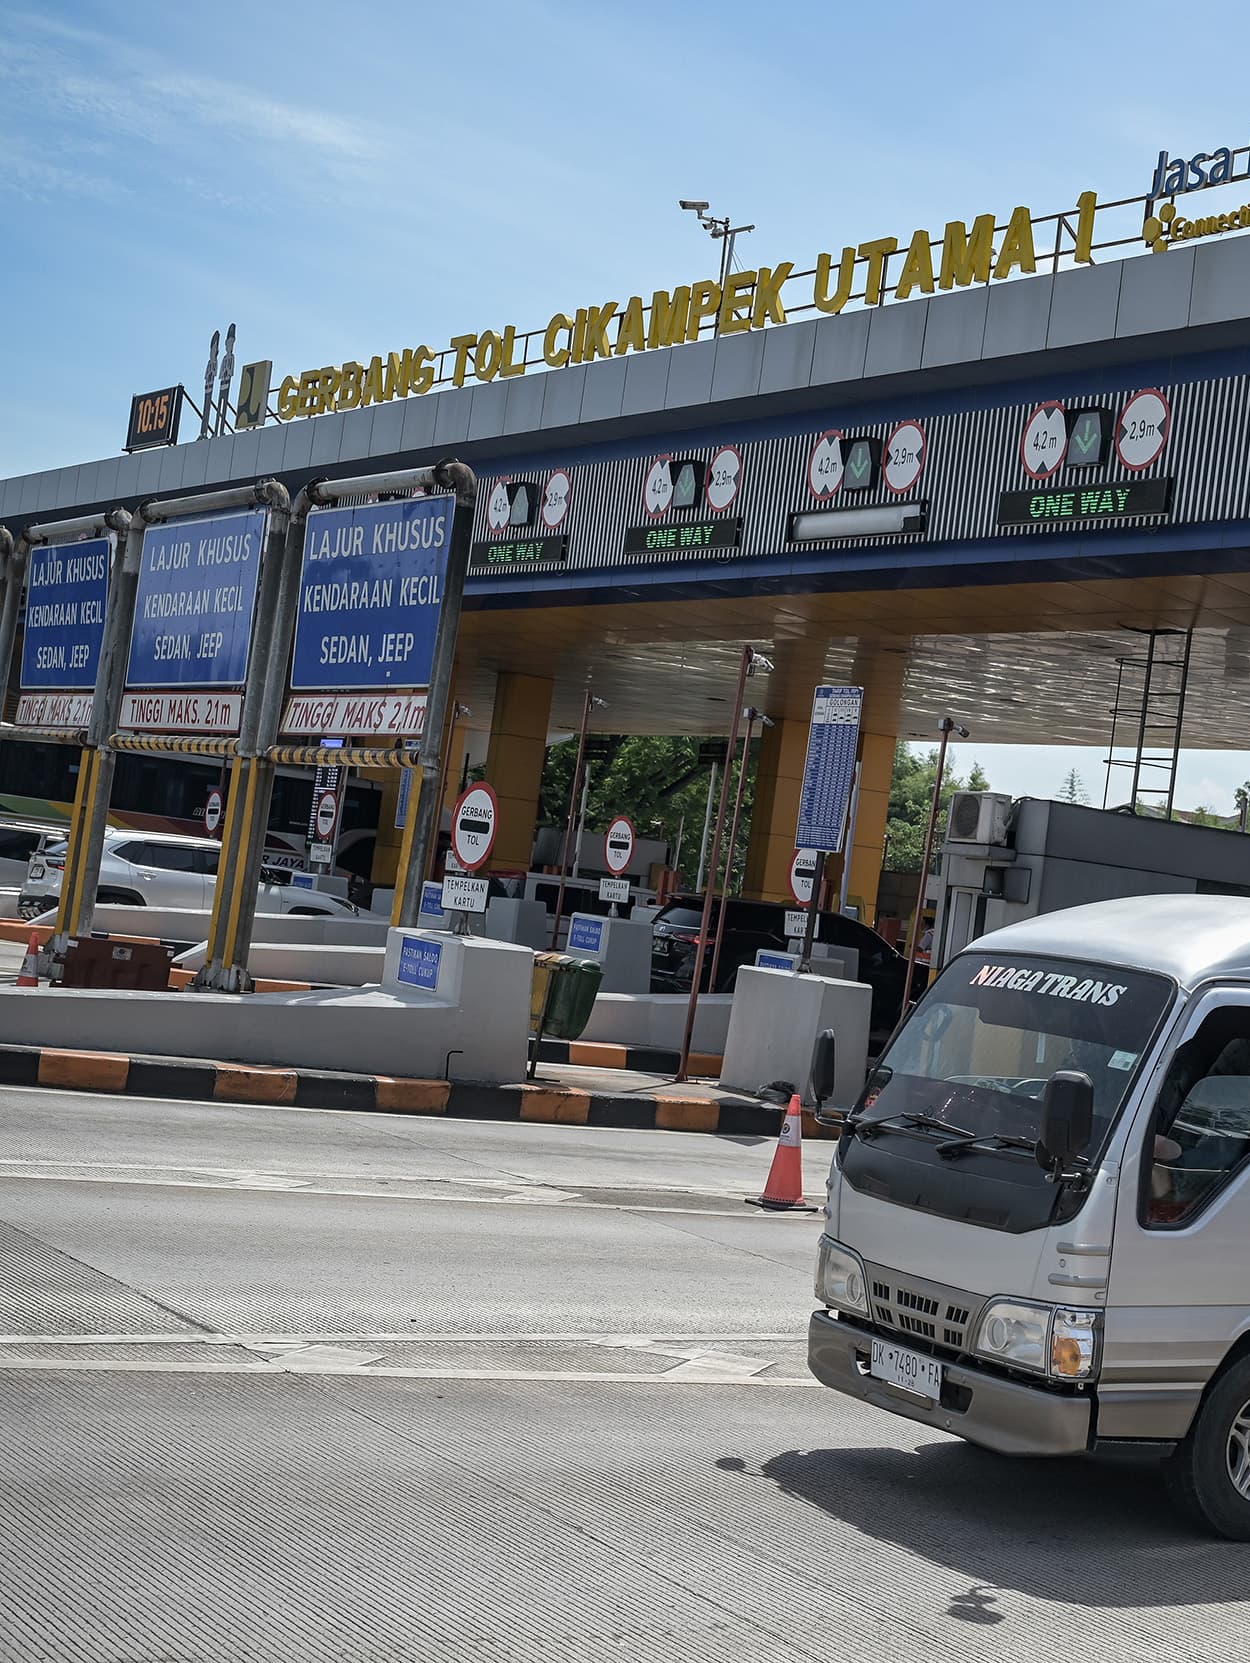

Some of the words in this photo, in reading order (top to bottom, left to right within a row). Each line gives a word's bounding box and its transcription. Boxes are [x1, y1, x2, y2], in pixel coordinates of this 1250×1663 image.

[1146, 145, 1234, 200] Jasa
[277, 345, 436, 421] GERBANG
[451, 325, 526, 388] TOL
[543, 262, 795, 368] CIKAMPEK
[813, 206, 1037, 314] UTAMA
[136, 394, 170, 436] 10:15
[1029, 495, 1075, 518] ONE
[1080, 488, 1130, 514] WAY
[309, 526, 364, 561] LAJUR
[372, 516, 446, 554] KHUSUS
[646, 529, 676, 548] ONE
[680, 525, 715, 545] WAY
[150, 542, 191, 572] LAJUR
[198, 533, 252, 566] KHUSUS
[488, 545, 513, 562] ONE
[516, 543, 543, 561] WAY
[32, 560, 63, 587] LAJUR
[66, 554, 105, 584] KHUSUS
[143, 589, 211, 619] KENDARAAN
[213, 585, 243, 616] KECIL
[303, 578, 393, 613] KENDARAAN
[400, 575, 440, 607] KECIL
[28, 602, 78, 628] KENDARAAN
[80, 600, 103, 625] KECIL
[36, 646, 67, 671] SEDAN,
[69, 644, 90, 669] JEEP
[153, 634, 192, 662] SEDAN,
[196, 631, 224, 659] JEEP
[319, 634, 372, 667] SEDAN,
[378, 632, 415, 663] JEEP
[18, 699, 48, 722] TINGGI
[130, 699, 163, 724] TINGGI
[288, 702, 338, 729] TINGGI
[340, 700, 387, 730] MAKS
[461, 805, 493, 820] GERBANG
[466, 834, 480, 846] TOL
[610, 831, 631, 841] GERBANG
[271, 855, 305, 869] JAYA
[614, 850, 622, 859] TOL
[795, 858, 816, 868] GERBAN
[447, 879, 485, 893] TEMPELKAN
[800, 880, 811, 889] TOL
[453, 896, 475, 908] KARTU
[787, 913, 807, 923] TEMPEL
[969, 965, 1044, 992] NIAGA
[1037, 973, 1128, 1007] TRANS
[872, 1341, 884, 1366] DK
[894, 1350, 918, 1378] 7480
[928, 1362, 940, 1387] FA
